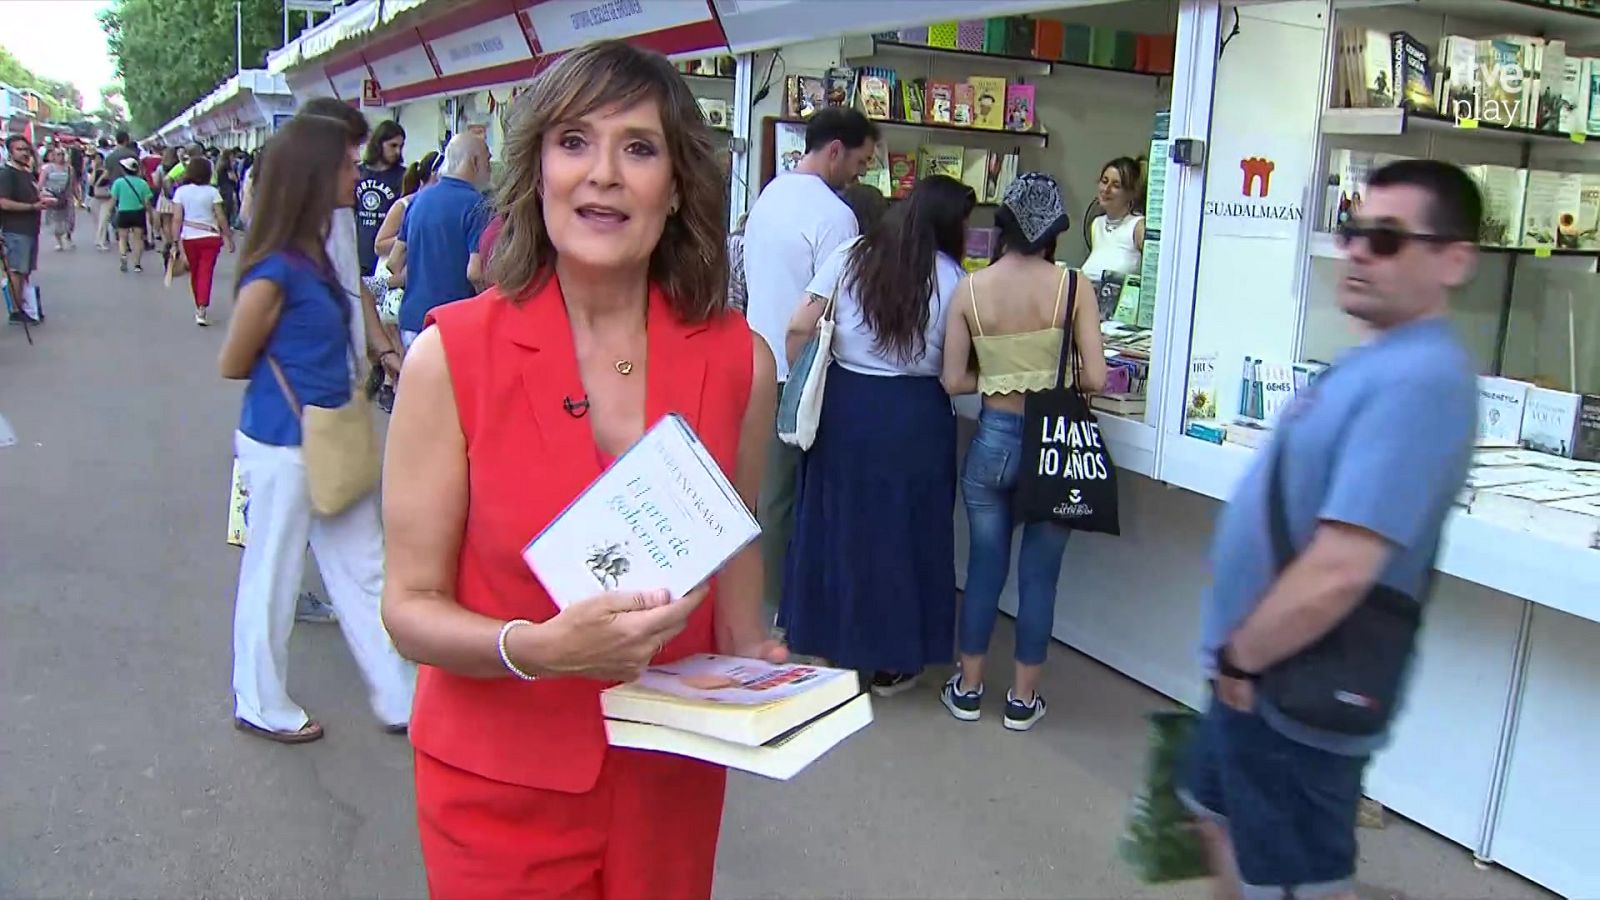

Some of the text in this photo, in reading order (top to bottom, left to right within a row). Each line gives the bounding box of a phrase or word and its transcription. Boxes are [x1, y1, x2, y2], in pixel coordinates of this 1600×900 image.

[1204, 201, 1304, 221] GUADALMAZÁN
[1266, 382, 1291, 392] GENES
[1041, 416, 1066, 443] LA
[1063, 449, 1107, 480] AÑOS
[606, 494, 673, 569] gobernar
[641, 501, 672, 533] arte
[668, 536, 690, 557] de
